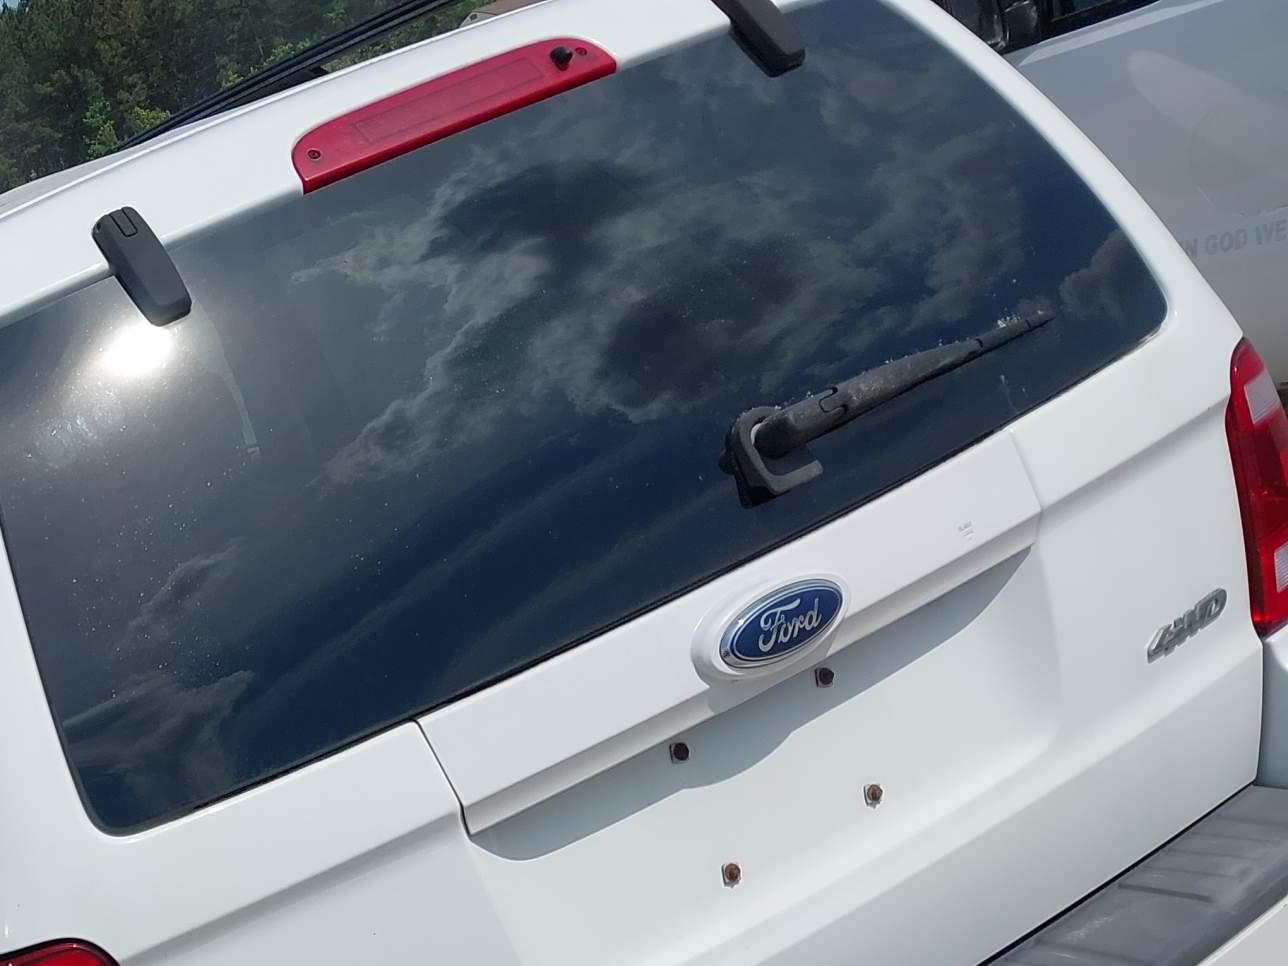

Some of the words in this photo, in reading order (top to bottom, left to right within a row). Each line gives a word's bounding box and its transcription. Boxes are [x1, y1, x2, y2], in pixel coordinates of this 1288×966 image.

[1205, 228, 1249, 256] GOD
[1255, 219, 1288, 246] WE
[758, 598, 823, 652] Ford
[1146, 588, 1227, 664] 4WD
